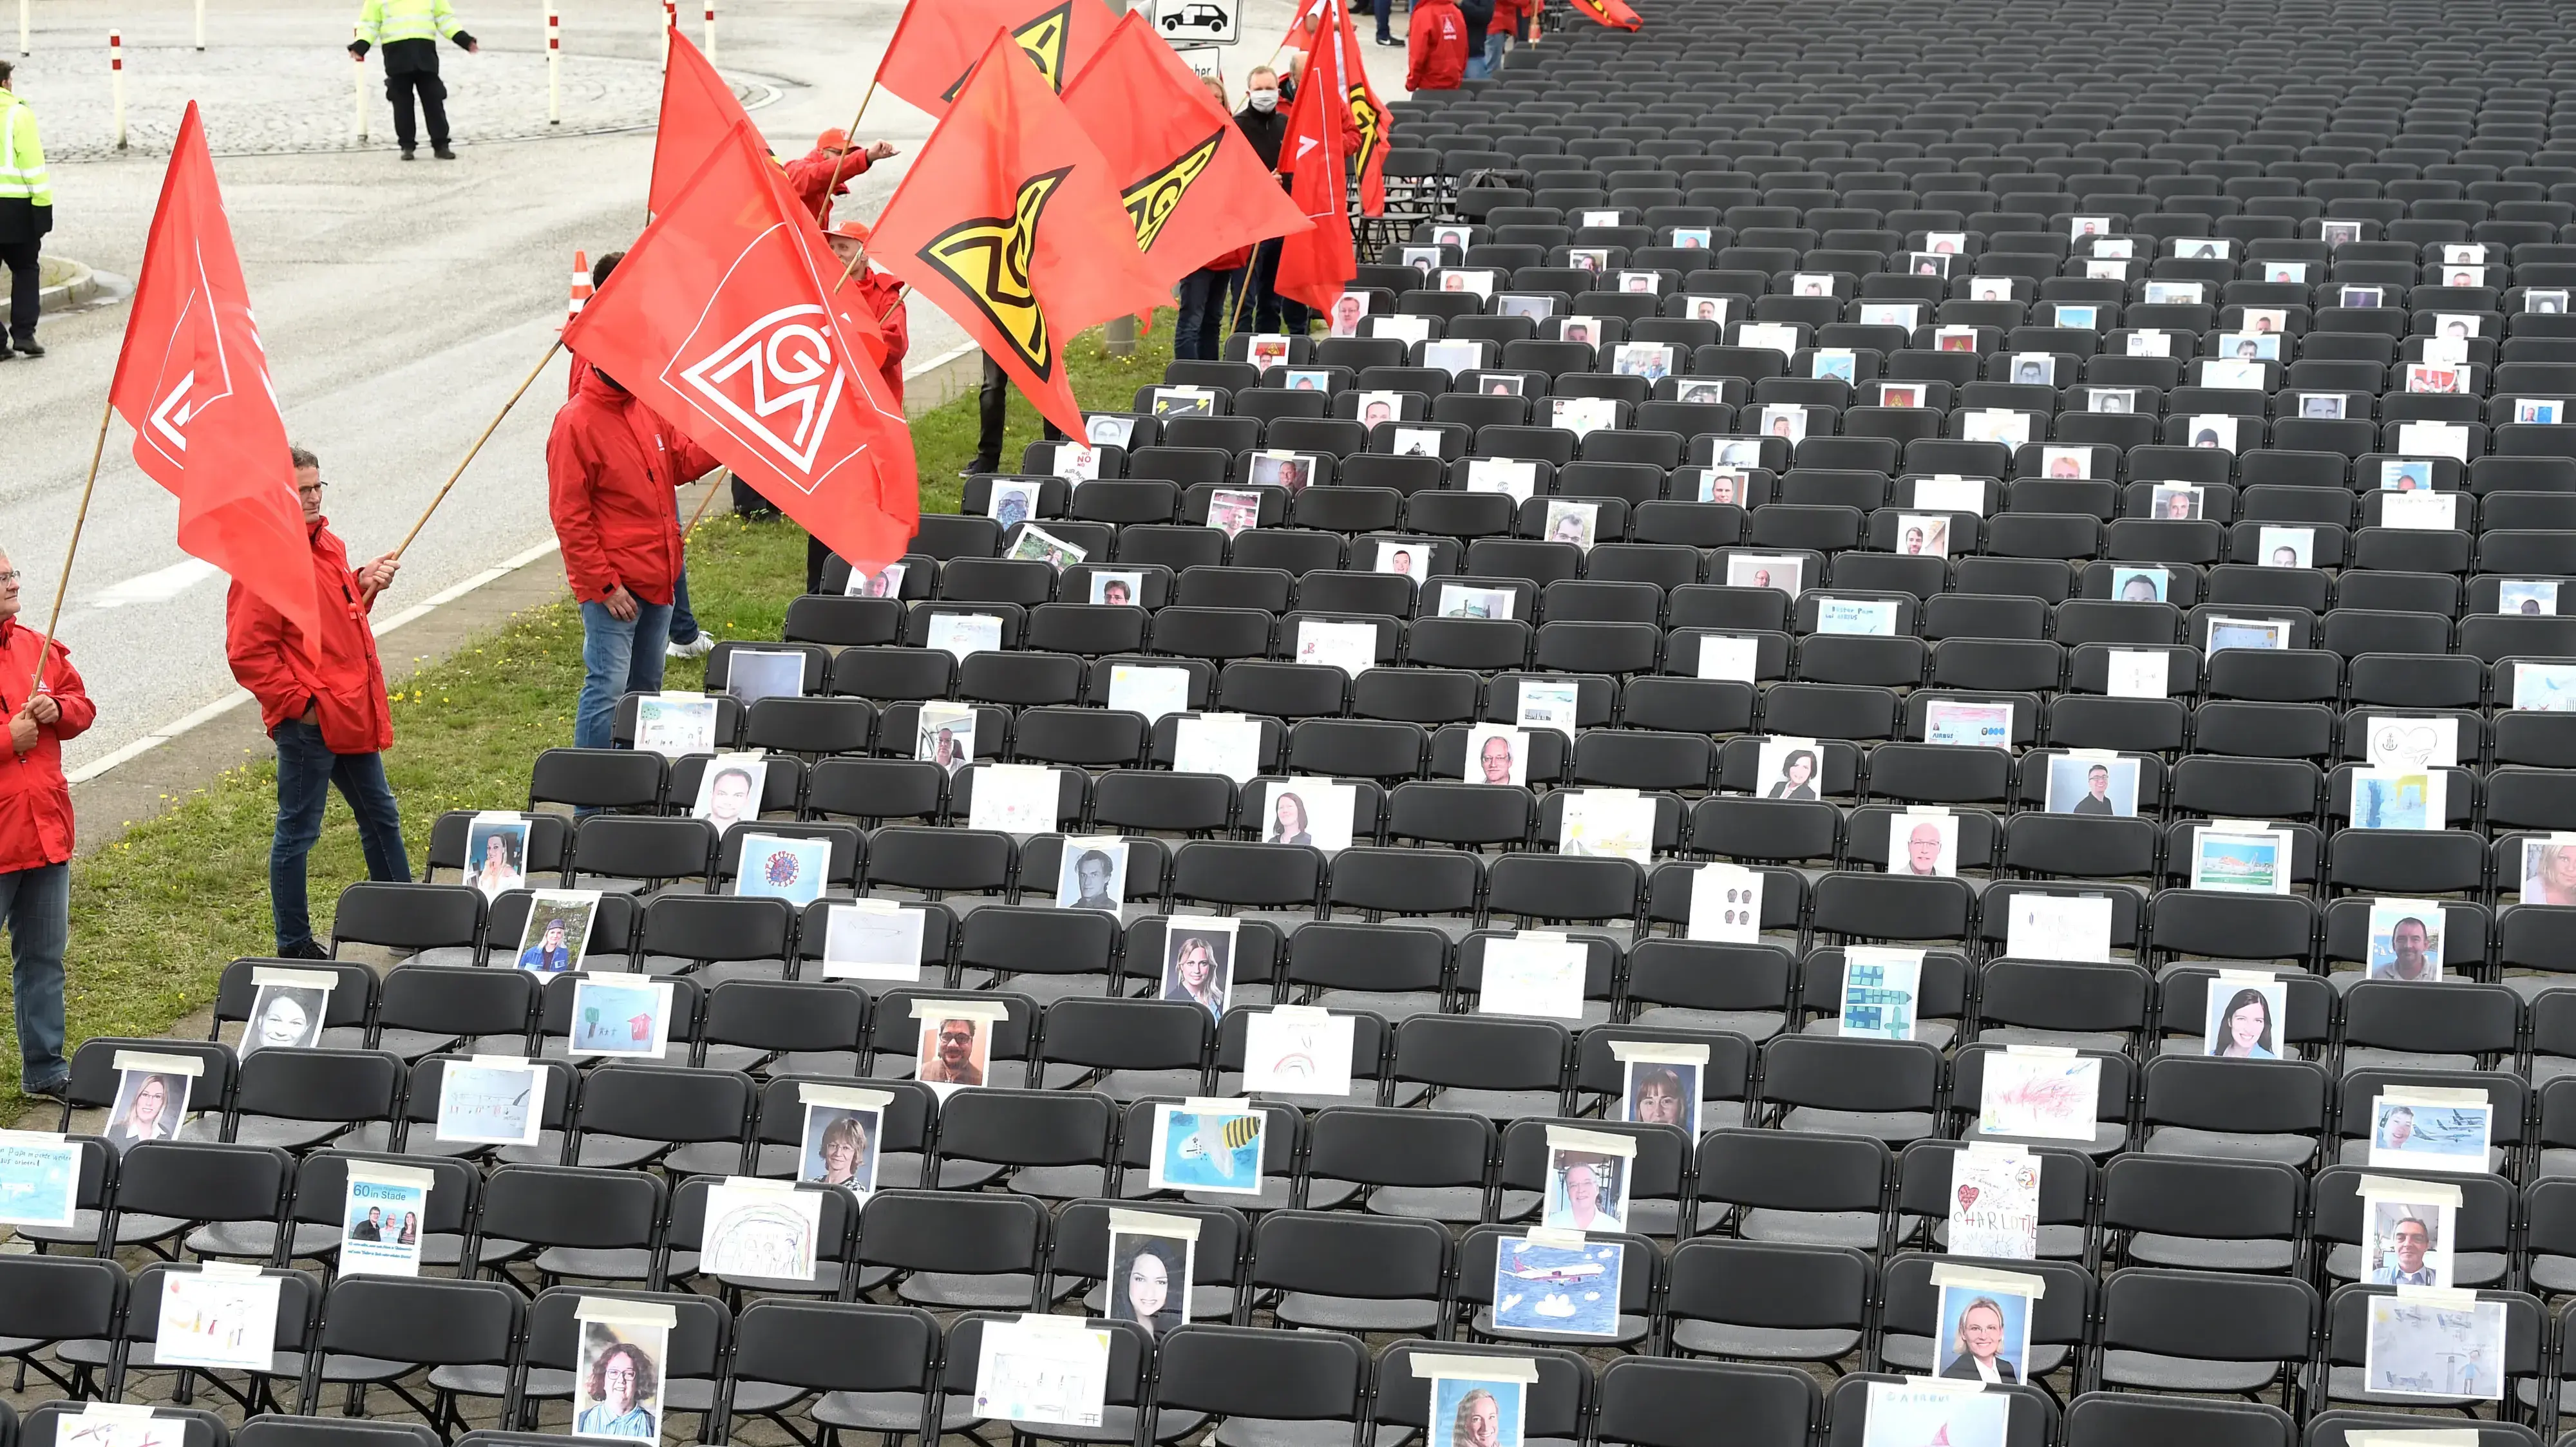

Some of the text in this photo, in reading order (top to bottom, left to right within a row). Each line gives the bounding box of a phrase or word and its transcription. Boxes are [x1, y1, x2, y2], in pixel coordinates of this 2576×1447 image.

[353, 1184, 370, 1197] 60
[370, 1190, 379, 1198] in
[381, 1191, 406, 1201] Stade
